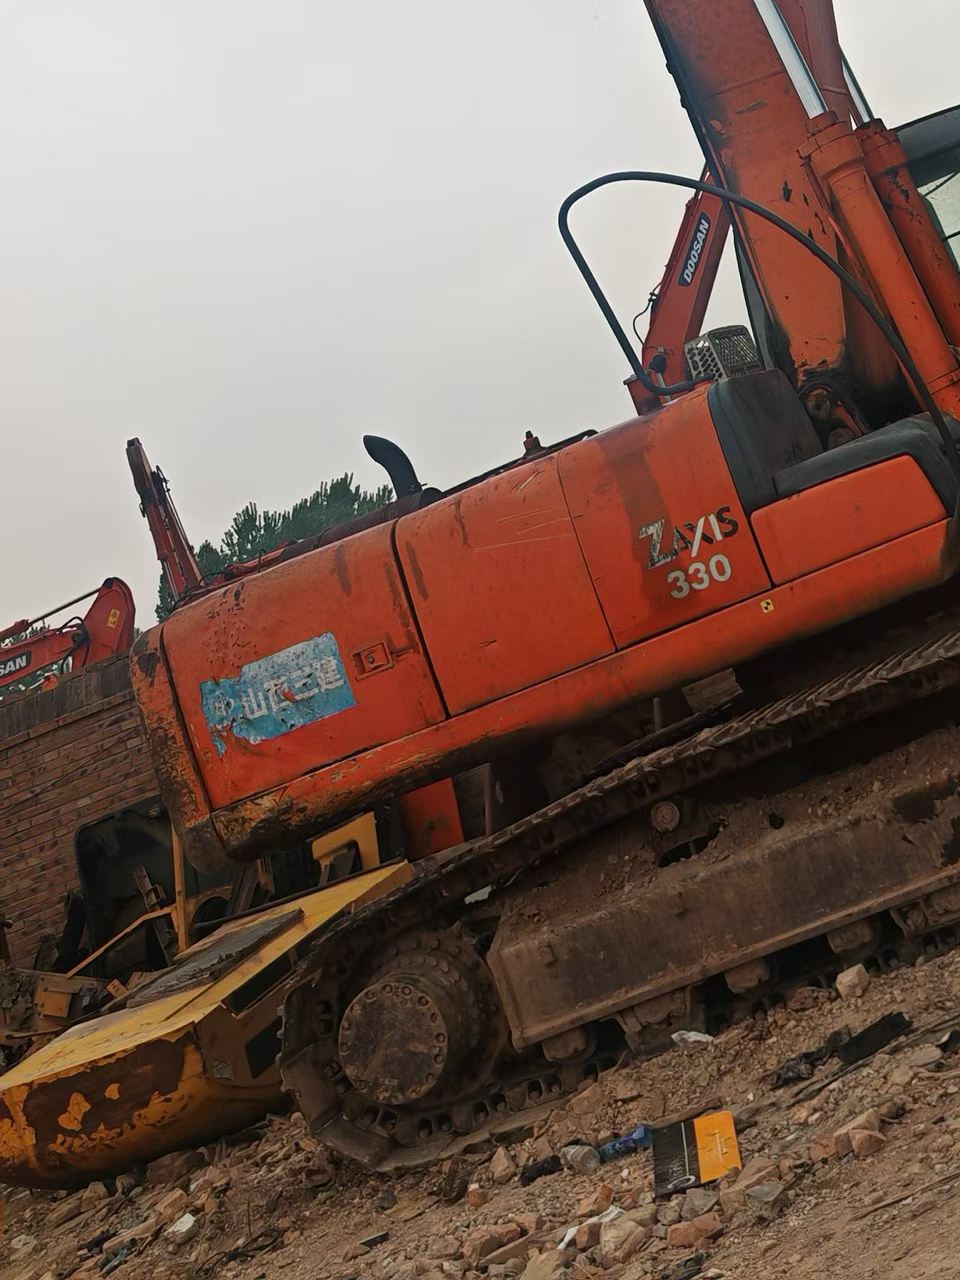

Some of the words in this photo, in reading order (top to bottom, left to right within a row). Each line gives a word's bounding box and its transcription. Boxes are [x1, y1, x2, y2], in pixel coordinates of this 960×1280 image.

[683, 219, 709, 283] DOOSAN
[639, 506, 739, 569] ZAXIS
[667, 553, 732, 599] 330
